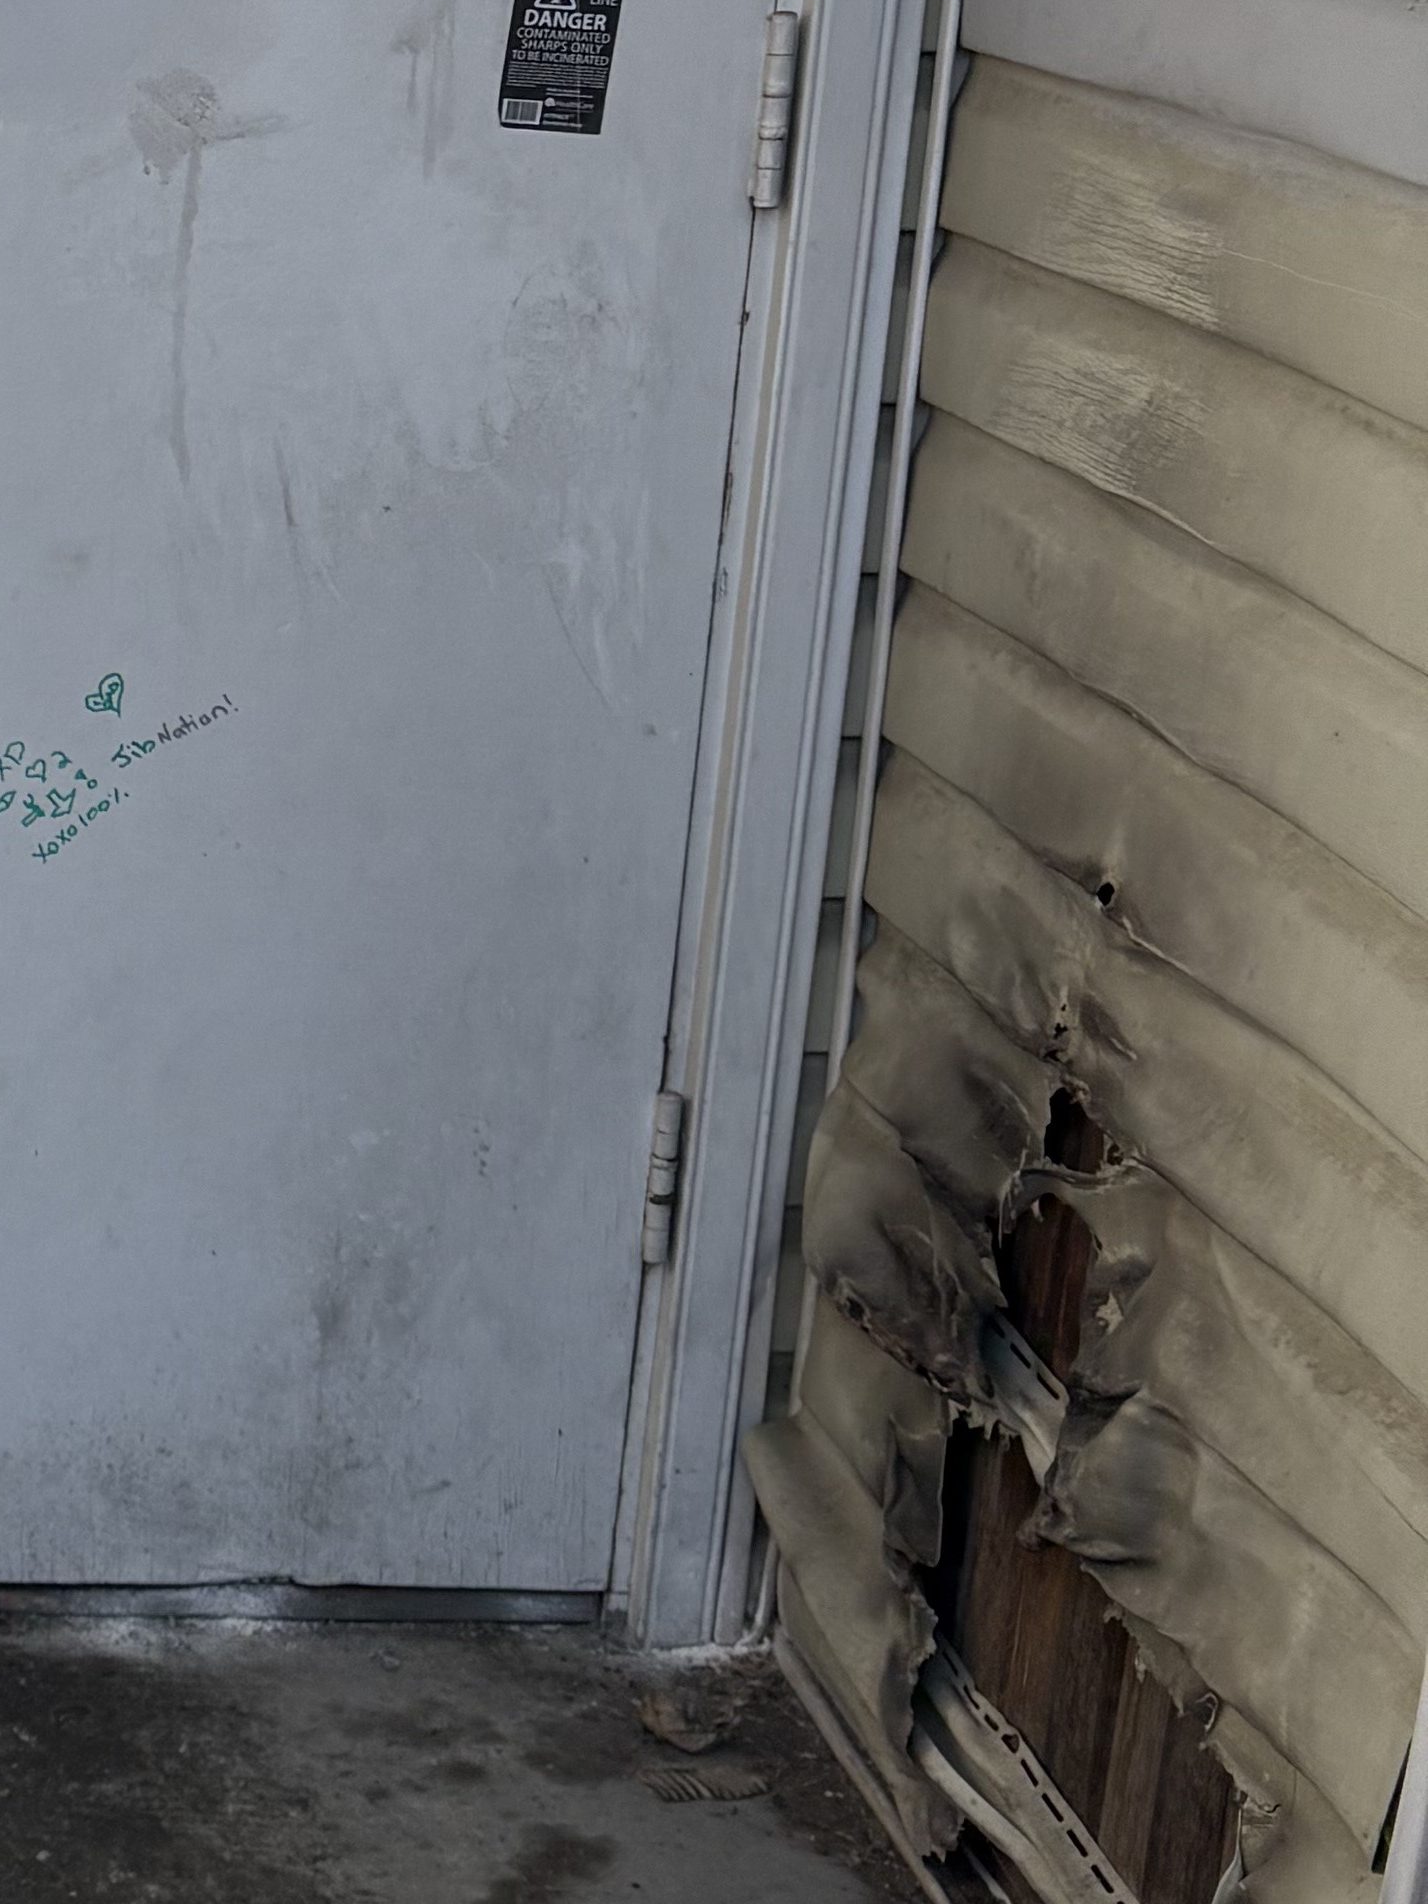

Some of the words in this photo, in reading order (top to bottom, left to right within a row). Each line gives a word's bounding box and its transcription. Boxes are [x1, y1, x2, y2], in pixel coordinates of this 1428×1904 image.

[524, 9, 607, 31] DANGER
[516, 27, 611, 44] CONTAMINATED
[521, 38, 568, 52] SHARPS
[570, 42, 604, 54] ONLY
[512, 49, 526, 60] TO
[527, 51, 541, 61] BE
[542, 52, 609, 66] INCINERATED
